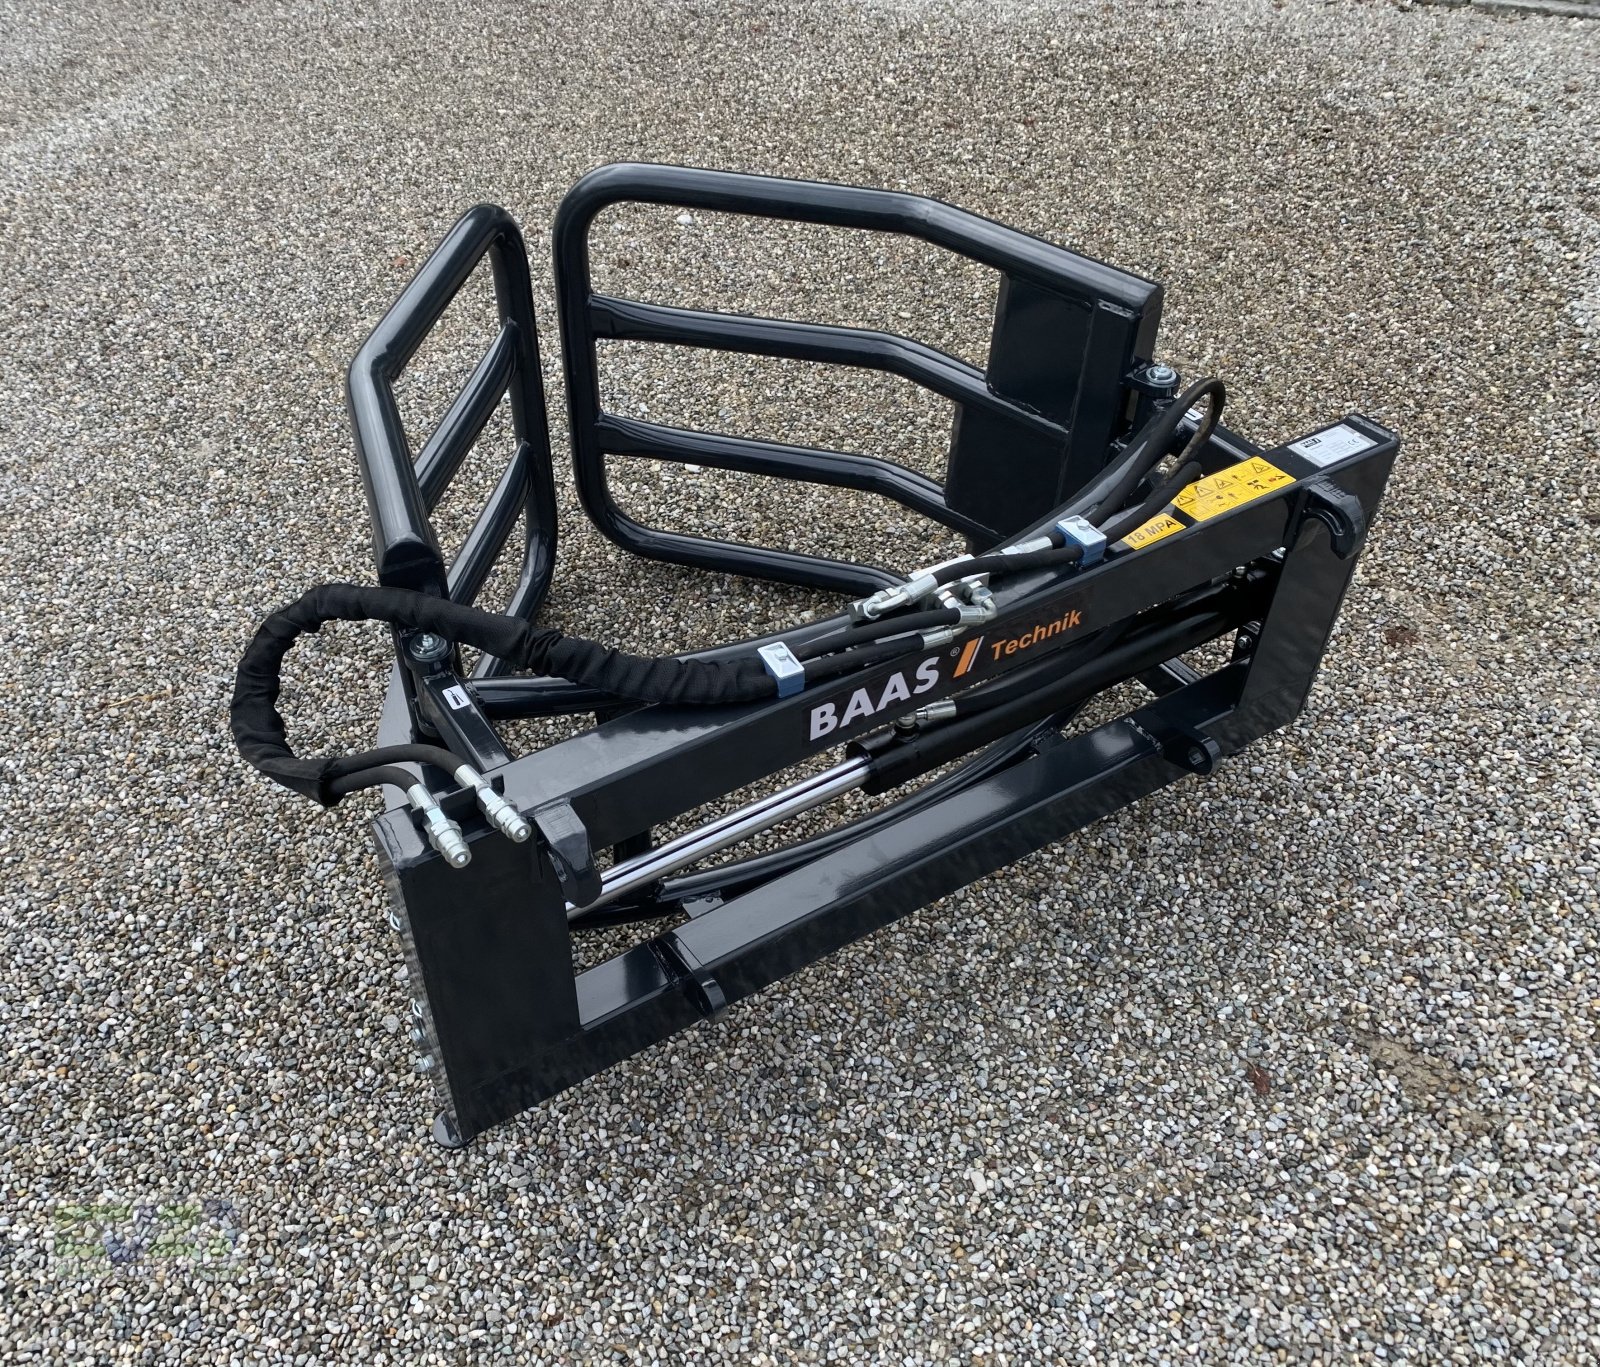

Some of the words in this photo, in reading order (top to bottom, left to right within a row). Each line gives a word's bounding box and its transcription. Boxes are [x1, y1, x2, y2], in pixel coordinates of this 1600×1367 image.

[1128, 532, 1145, 543] 18
[1145, 519, 1177, 535] MPA
[809, 656, 940, 742] BAAS
[991, 609, 1082, 661] Technik
